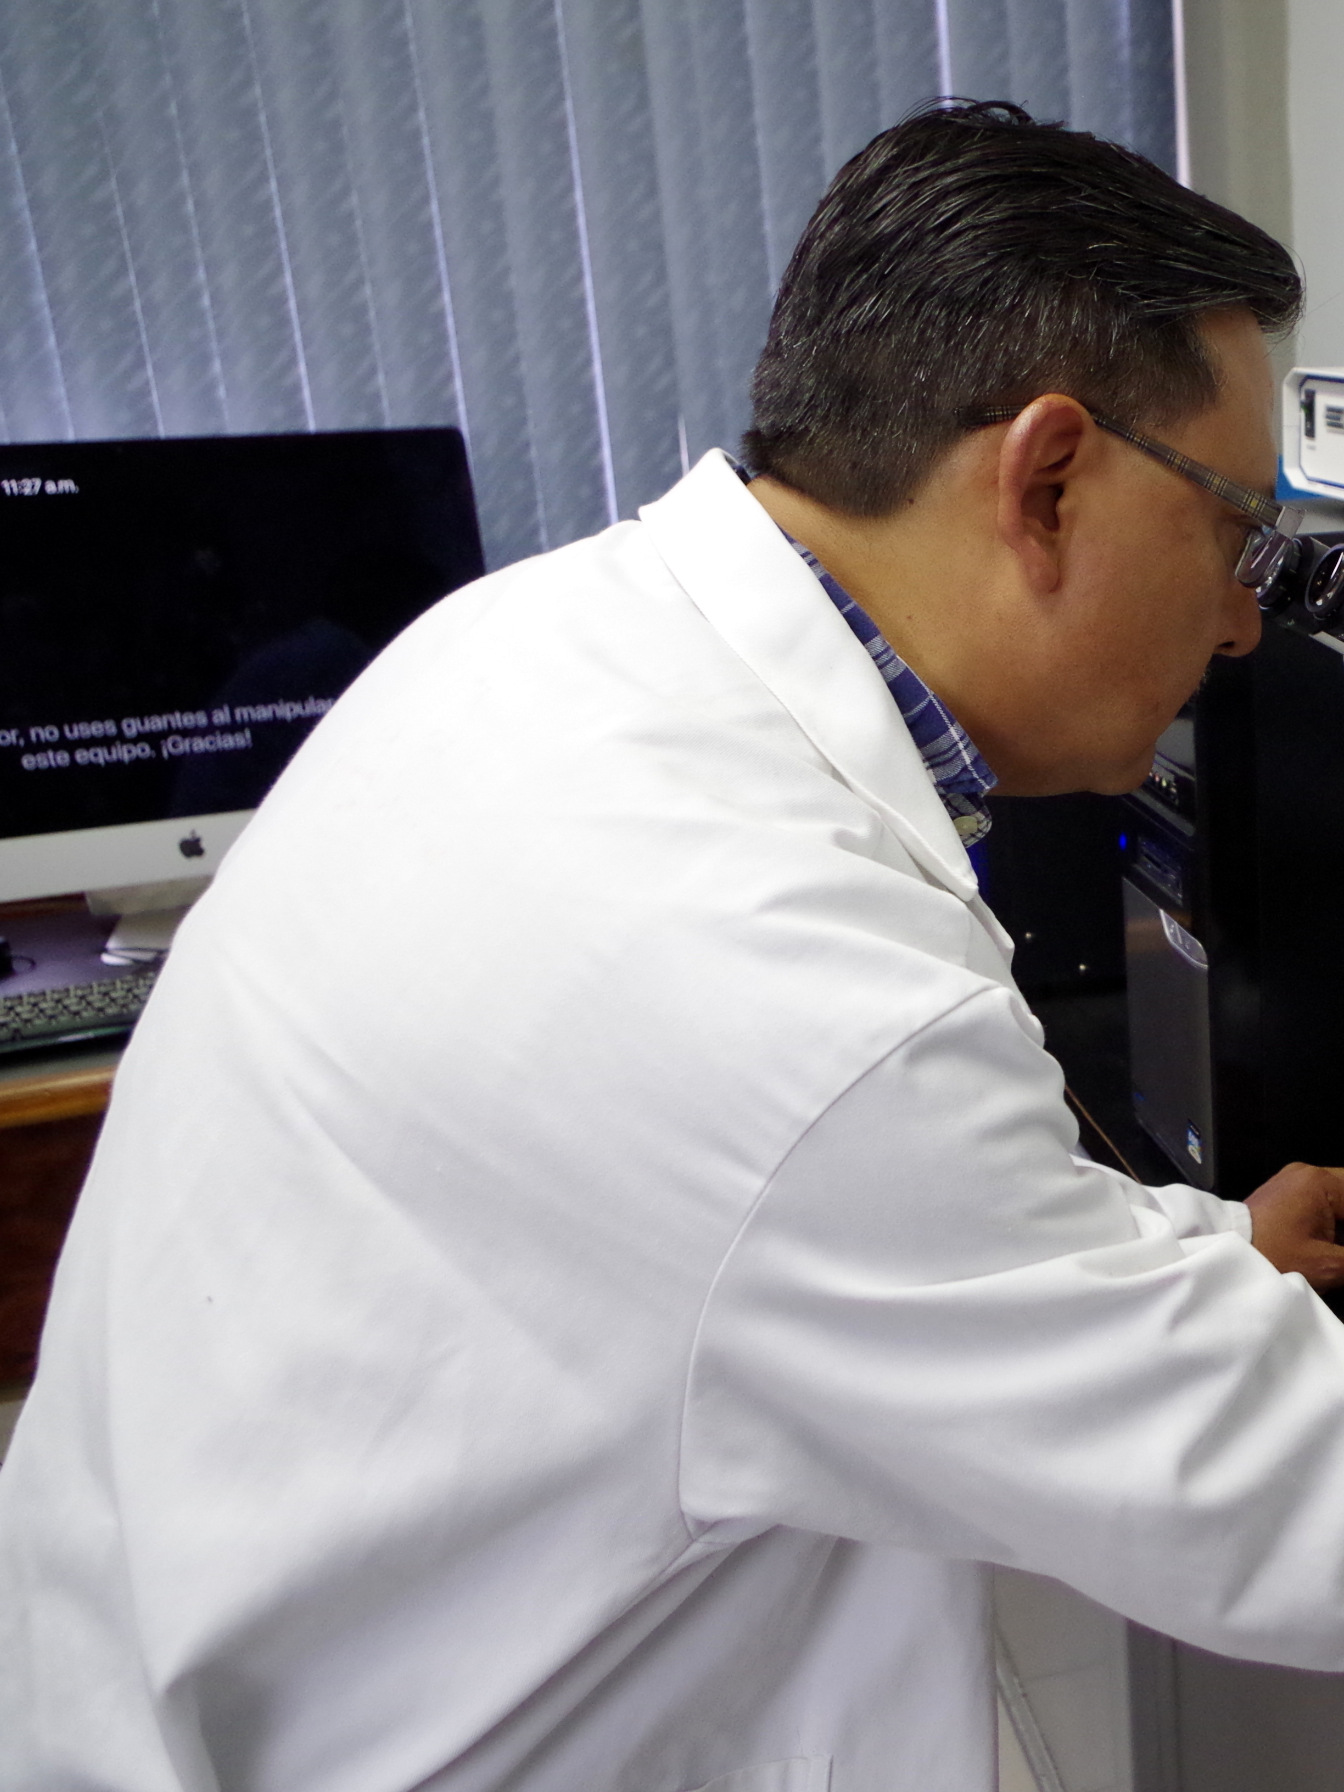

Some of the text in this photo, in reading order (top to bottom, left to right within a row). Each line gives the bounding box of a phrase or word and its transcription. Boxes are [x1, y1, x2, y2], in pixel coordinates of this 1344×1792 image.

[1, 477, 42, 496] 11:27
[29, 724, 60, 743] no
[63, 719, 118, 740] uses
[121, 709, 208, 739] guantes
[211, 703, 232, 726] al
[21, 727, 253, 771] este equipo. ¡Gracias!
